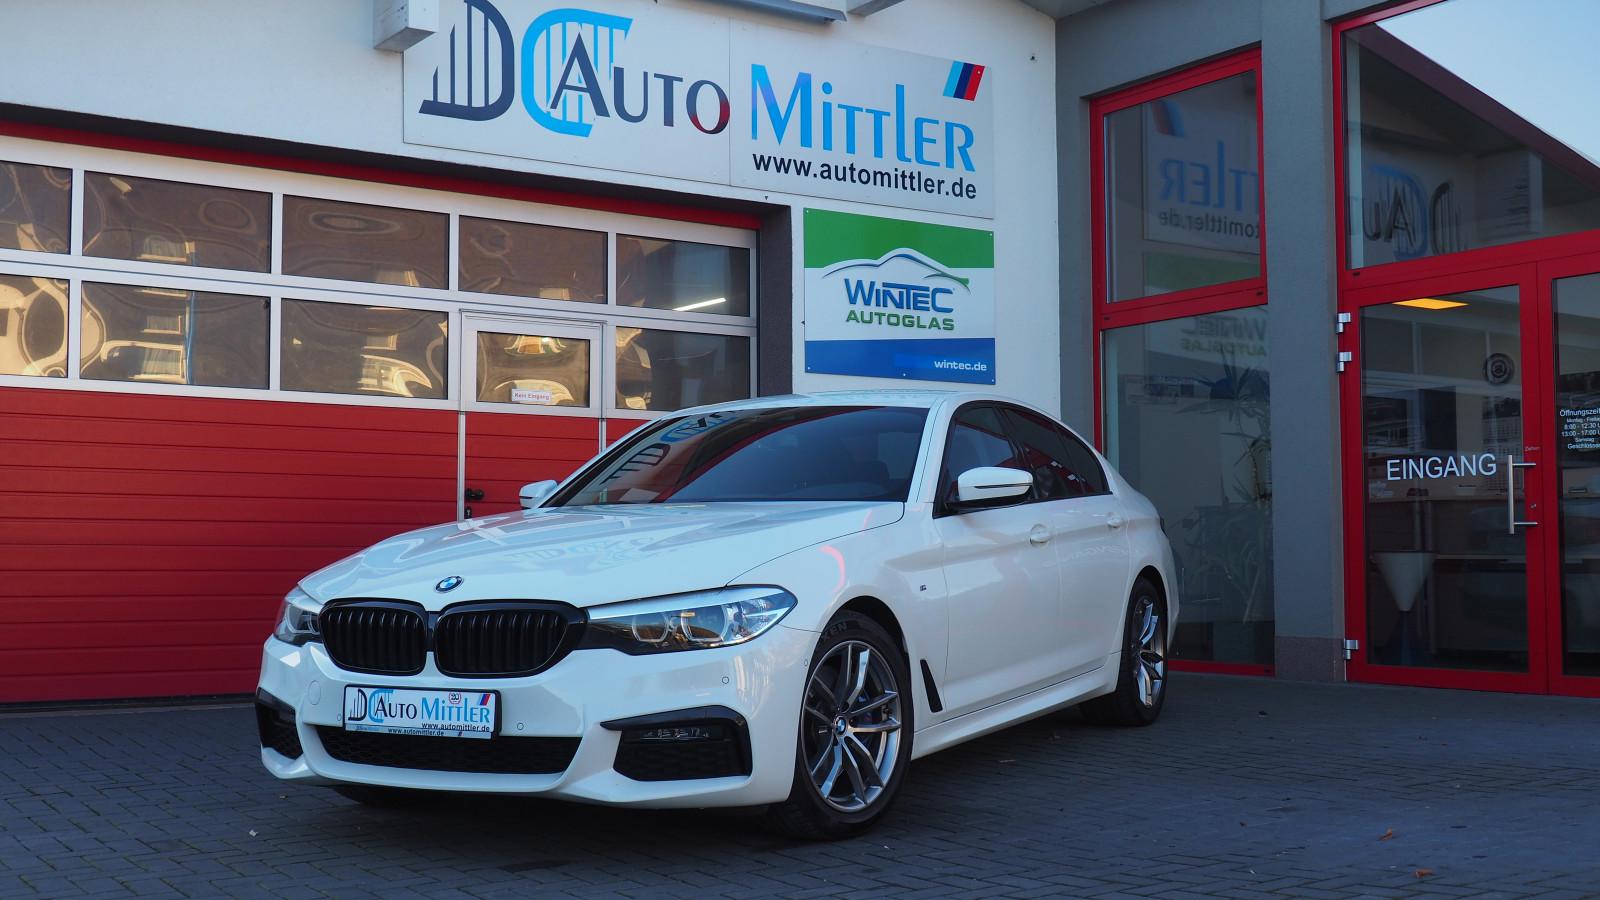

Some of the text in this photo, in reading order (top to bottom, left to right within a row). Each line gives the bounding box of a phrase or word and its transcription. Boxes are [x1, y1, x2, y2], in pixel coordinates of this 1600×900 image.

[753, 153, 977, 200] www.automittler.de
[846, 310, 955, 331] AUTOGLAS
[934, 360, 987, 372] wintec.de
[1386, 453, 1497, 481] EINGANG
[421, 722, 490, 732] www.automittler.de
